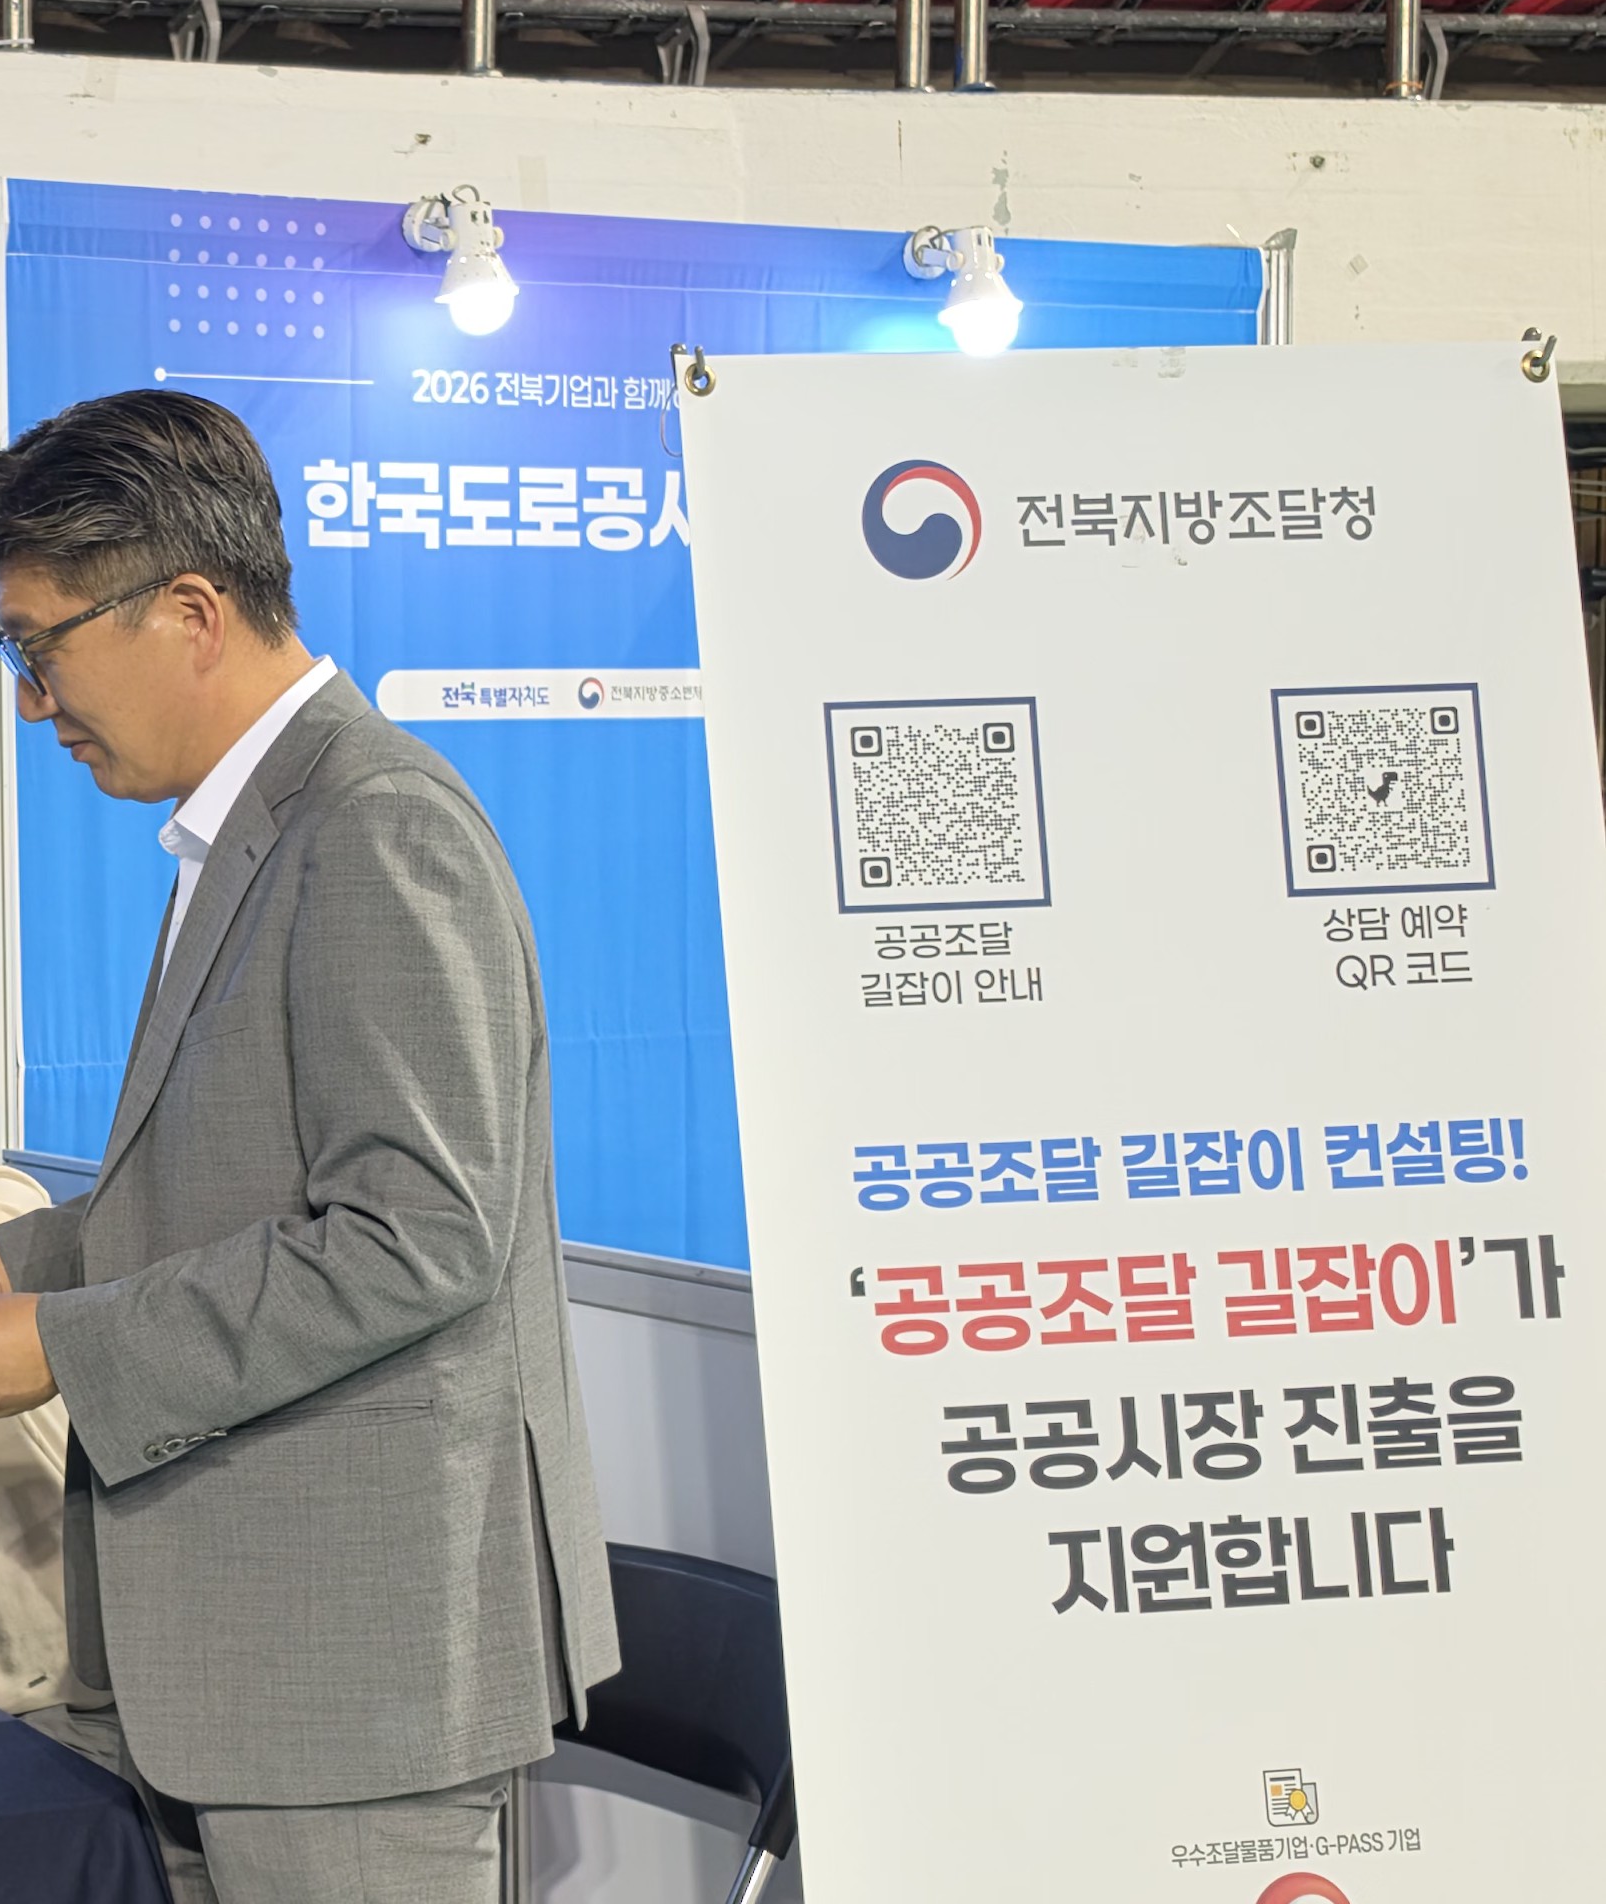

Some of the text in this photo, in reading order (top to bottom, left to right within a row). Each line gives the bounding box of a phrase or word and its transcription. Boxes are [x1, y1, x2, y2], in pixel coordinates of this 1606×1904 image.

[412, 369, 680, 411] 2026 전북기업과 함께
[1016, 485, 1376, 547] 전북지방조달청
[874, 921, 1013, 960] 공공조달
[1323, 903, 1468, 942] 상담 예약
[860, 966, 1043, 1008] 길잡이 안내
[1335, 950, 1473, 991] QR 코드
[852, 1117, 1529, 1211] 공공조달 길잡이 컨설팅!
[850, 1234, 1566, 1356] ‘공공조달 길잡이’가
[941, 1375, 1523, 1495] 공공시장 진출을
[1047, 1506, 1455, 1615] 지원합니다
[1386, 1827, 1421, 1852] 기업
